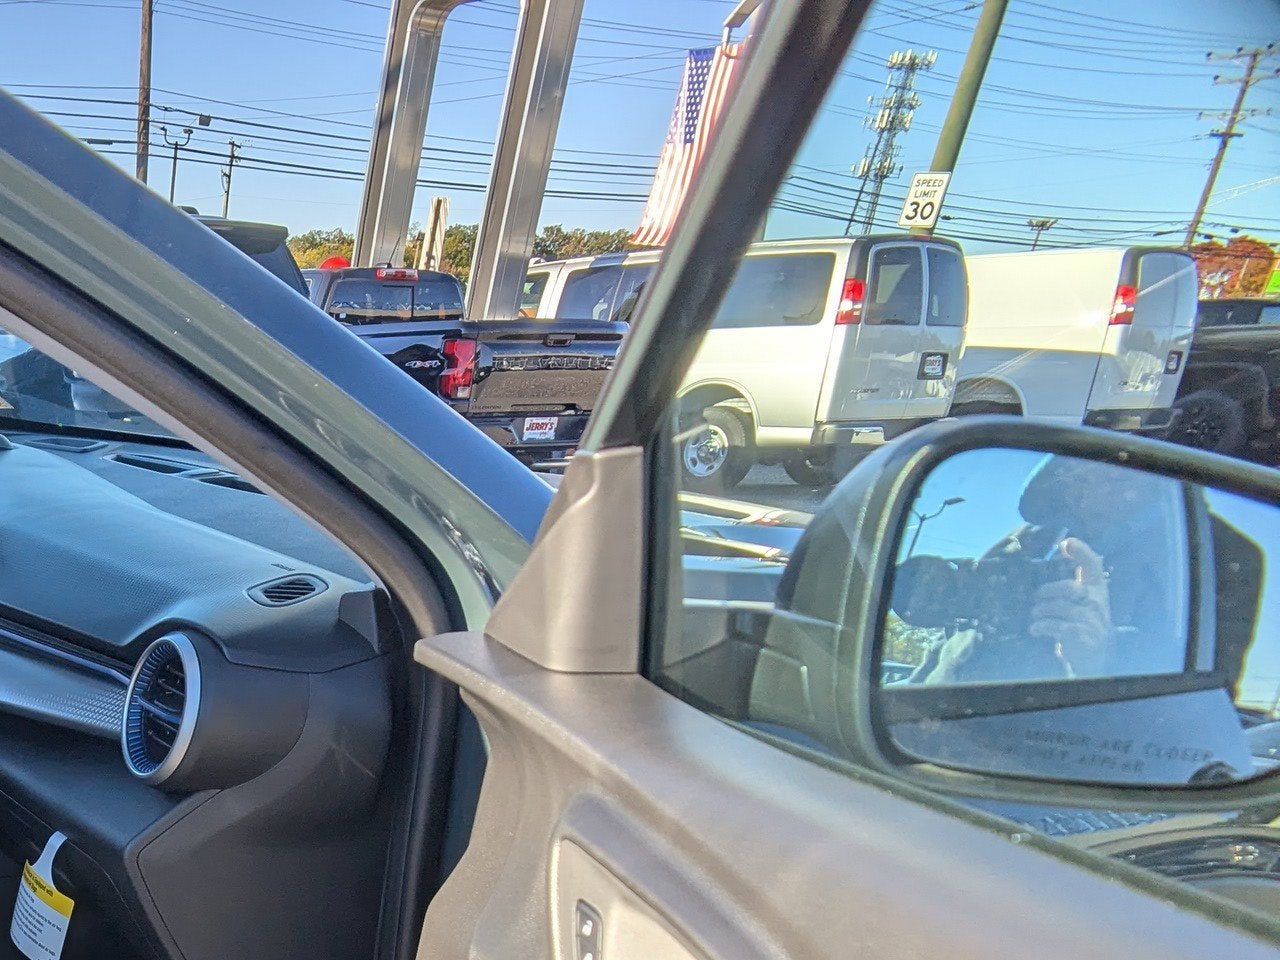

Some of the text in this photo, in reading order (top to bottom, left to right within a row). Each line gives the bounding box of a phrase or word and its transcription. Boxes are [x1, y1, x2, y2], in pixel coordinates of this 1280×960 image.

[915, 179, 944, 188] SPEED
[914, 190, 937, 199] LIMIT
[905, 201, 935, 220] 30
[526, 422, 554, 431] JERRY'S
